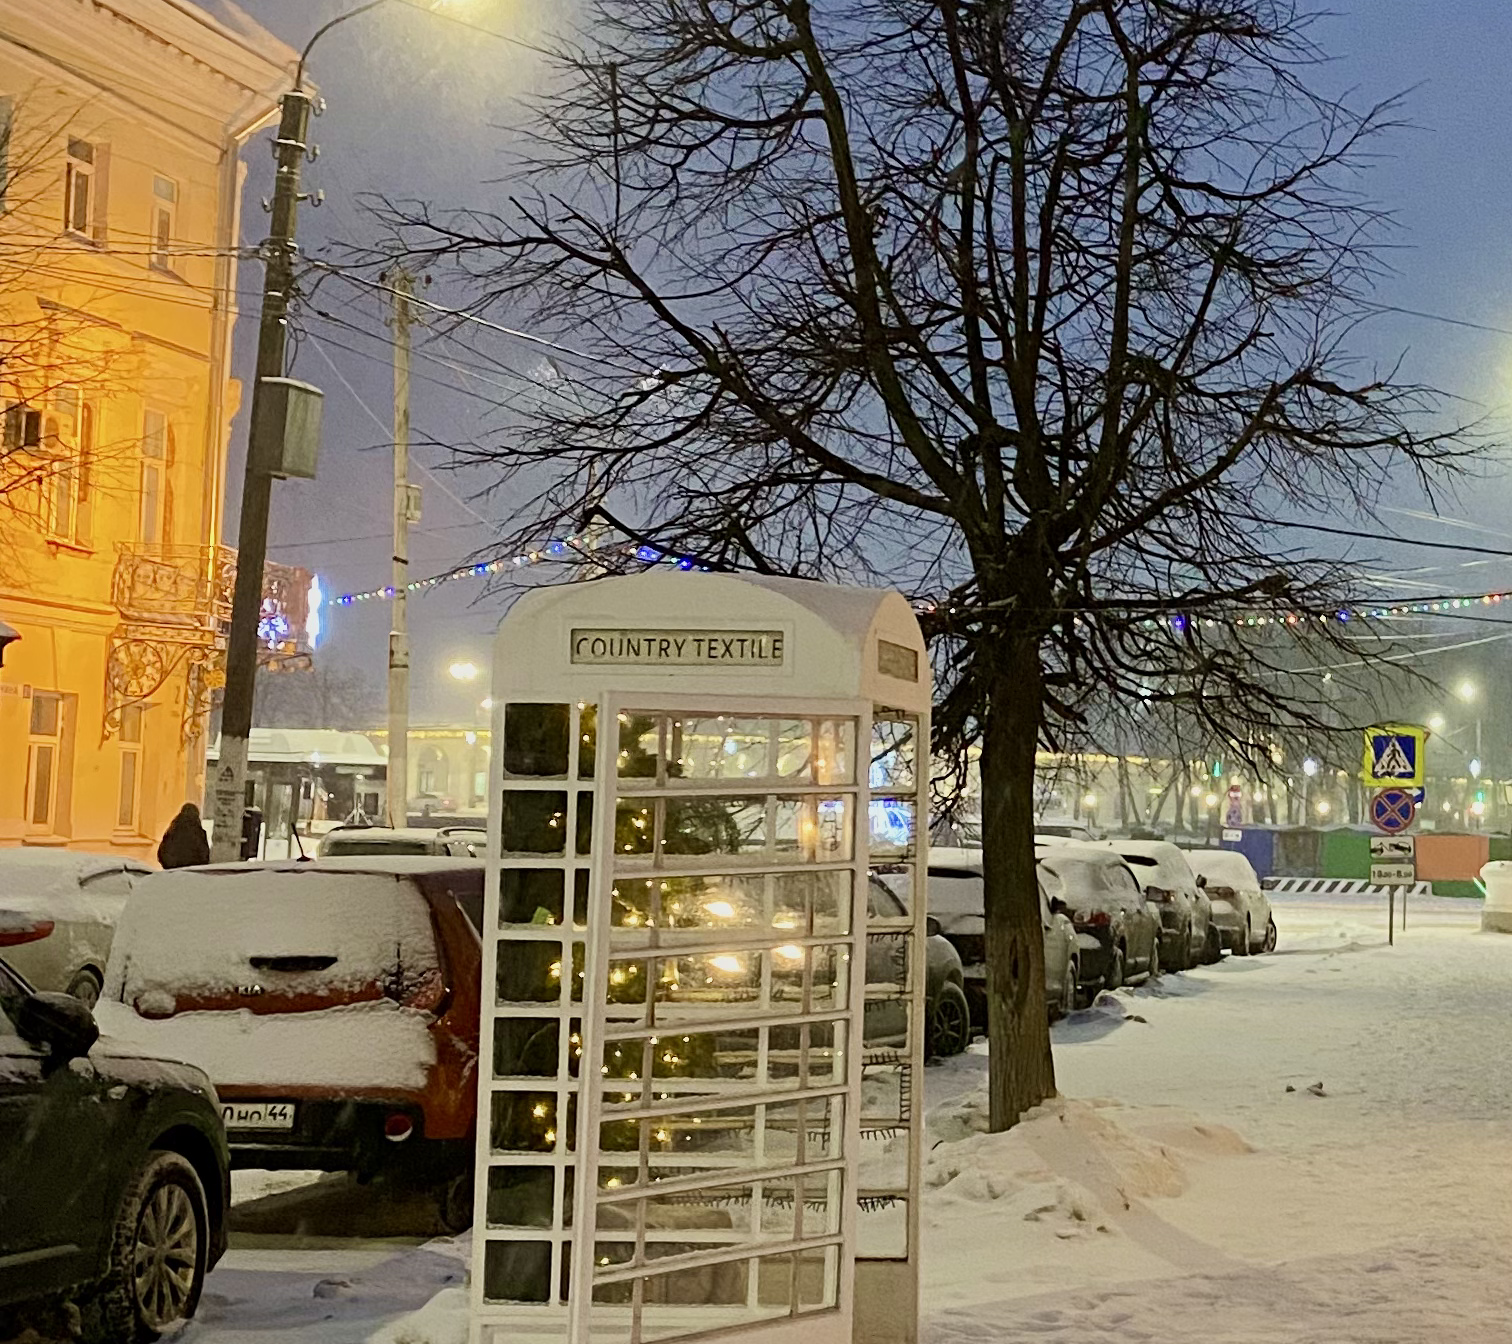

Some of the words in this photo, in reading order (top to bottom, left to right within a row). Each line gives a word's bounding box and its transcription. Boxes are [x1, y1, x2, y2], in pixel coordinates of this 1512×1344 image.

[576, 637, 686, 659] COUNTRY
[693, 638, 783, 659] TEXTILE
[238, 984, 262, 995] KIA
[268, 1105, 288, 1121] 44
